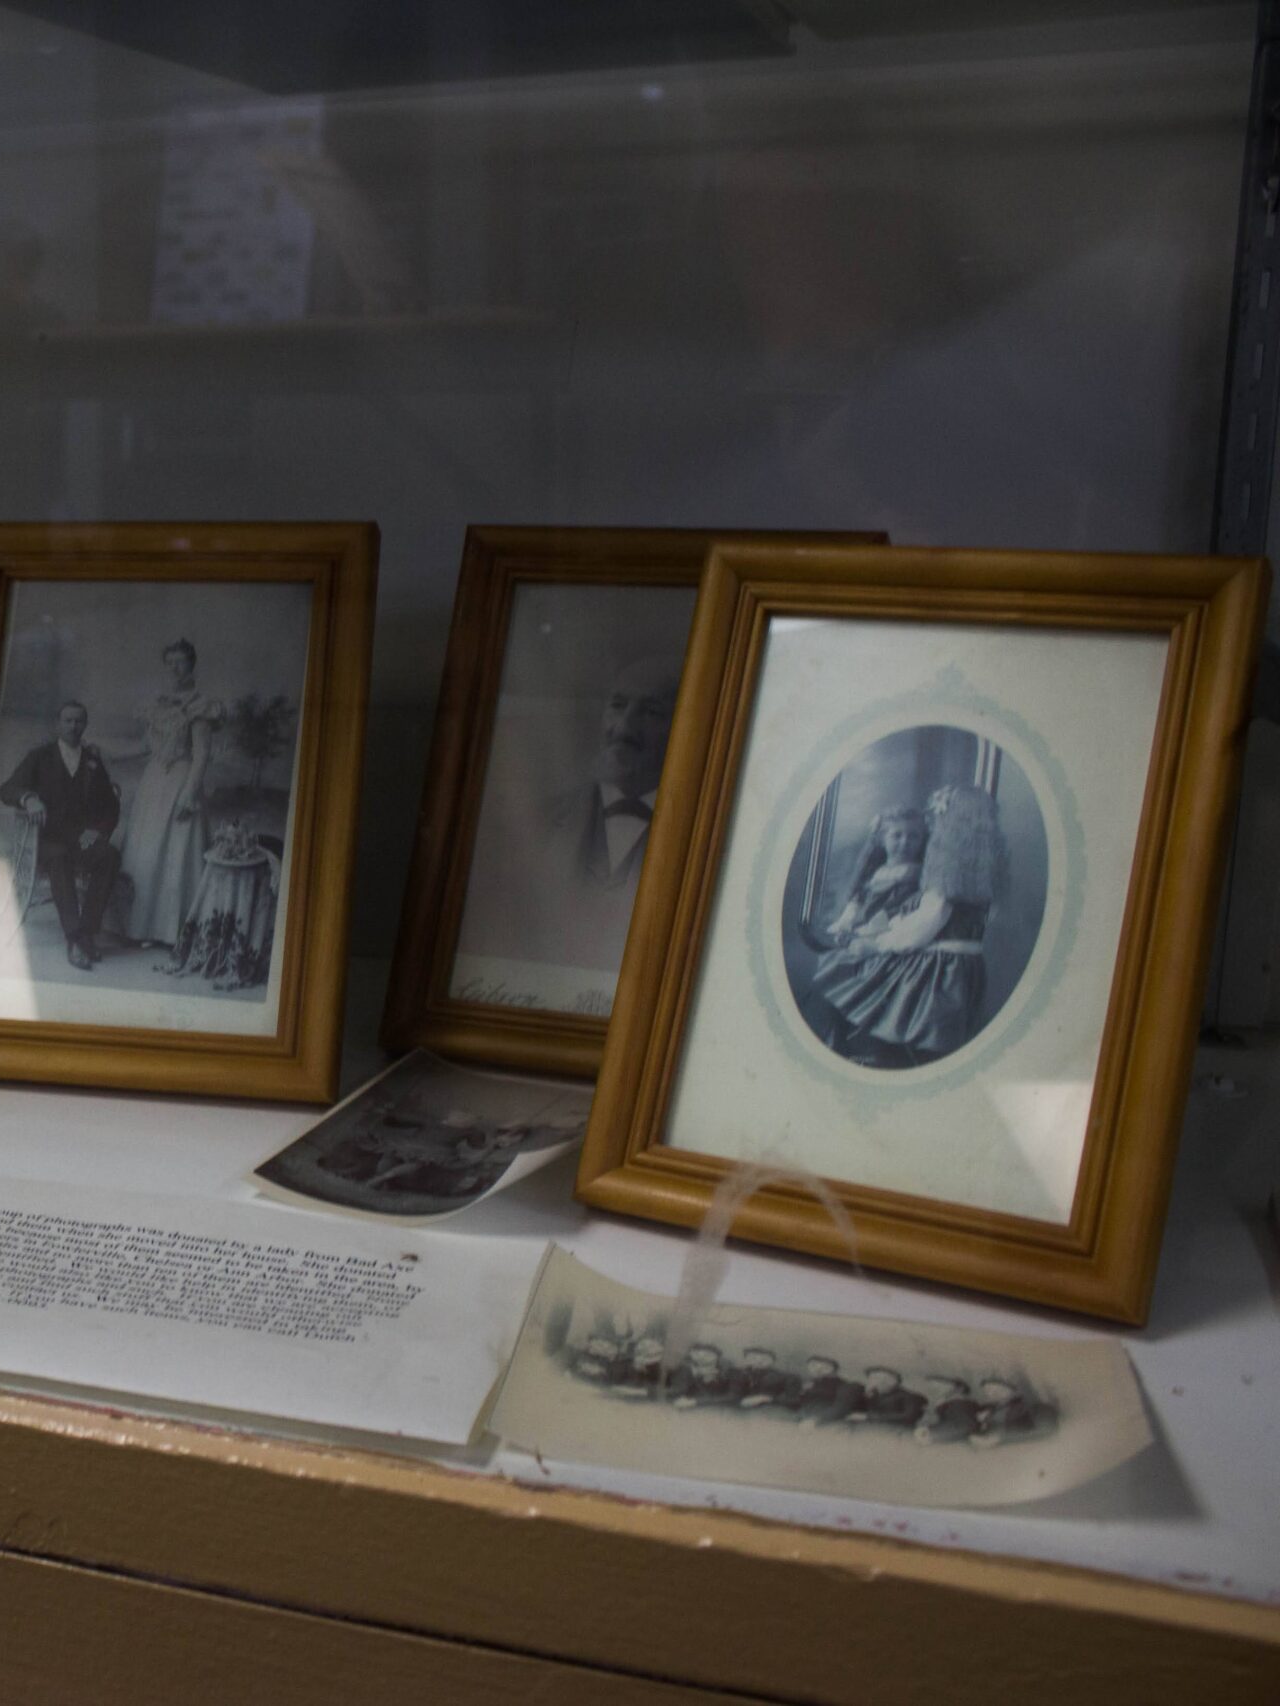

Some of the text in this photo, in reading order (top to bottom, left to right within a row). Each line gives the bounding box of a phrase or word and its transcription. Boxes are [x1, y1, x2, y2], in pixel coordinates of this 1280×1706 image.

[17, 1220, 52, 1232] them
[56, 1226, 95, 1238] when
[98, 1231, 123, 1241] she
[126, 1235, 177, 1248] moved
[180, 1242, 209, 1252] into
[214, 1246, 237, 1256] her
[302, 1259, 330, 1271] She
[334, 1263, 397, 1280] donated
[43, 1217, 132, 1233] photographs
[137, 1227, 164, 1236] was
[167, 1231, 227, 1246] donated
[304, 1250, 341, 1263] from
[346, 1256, 378, 1268] Bad
[123, 1243, 161, 1256] them
[165, 1250, 222, 1264] seemed
[267, 1264, 310, 1278] taken
[217, 1264, 250, 1277] Ann
